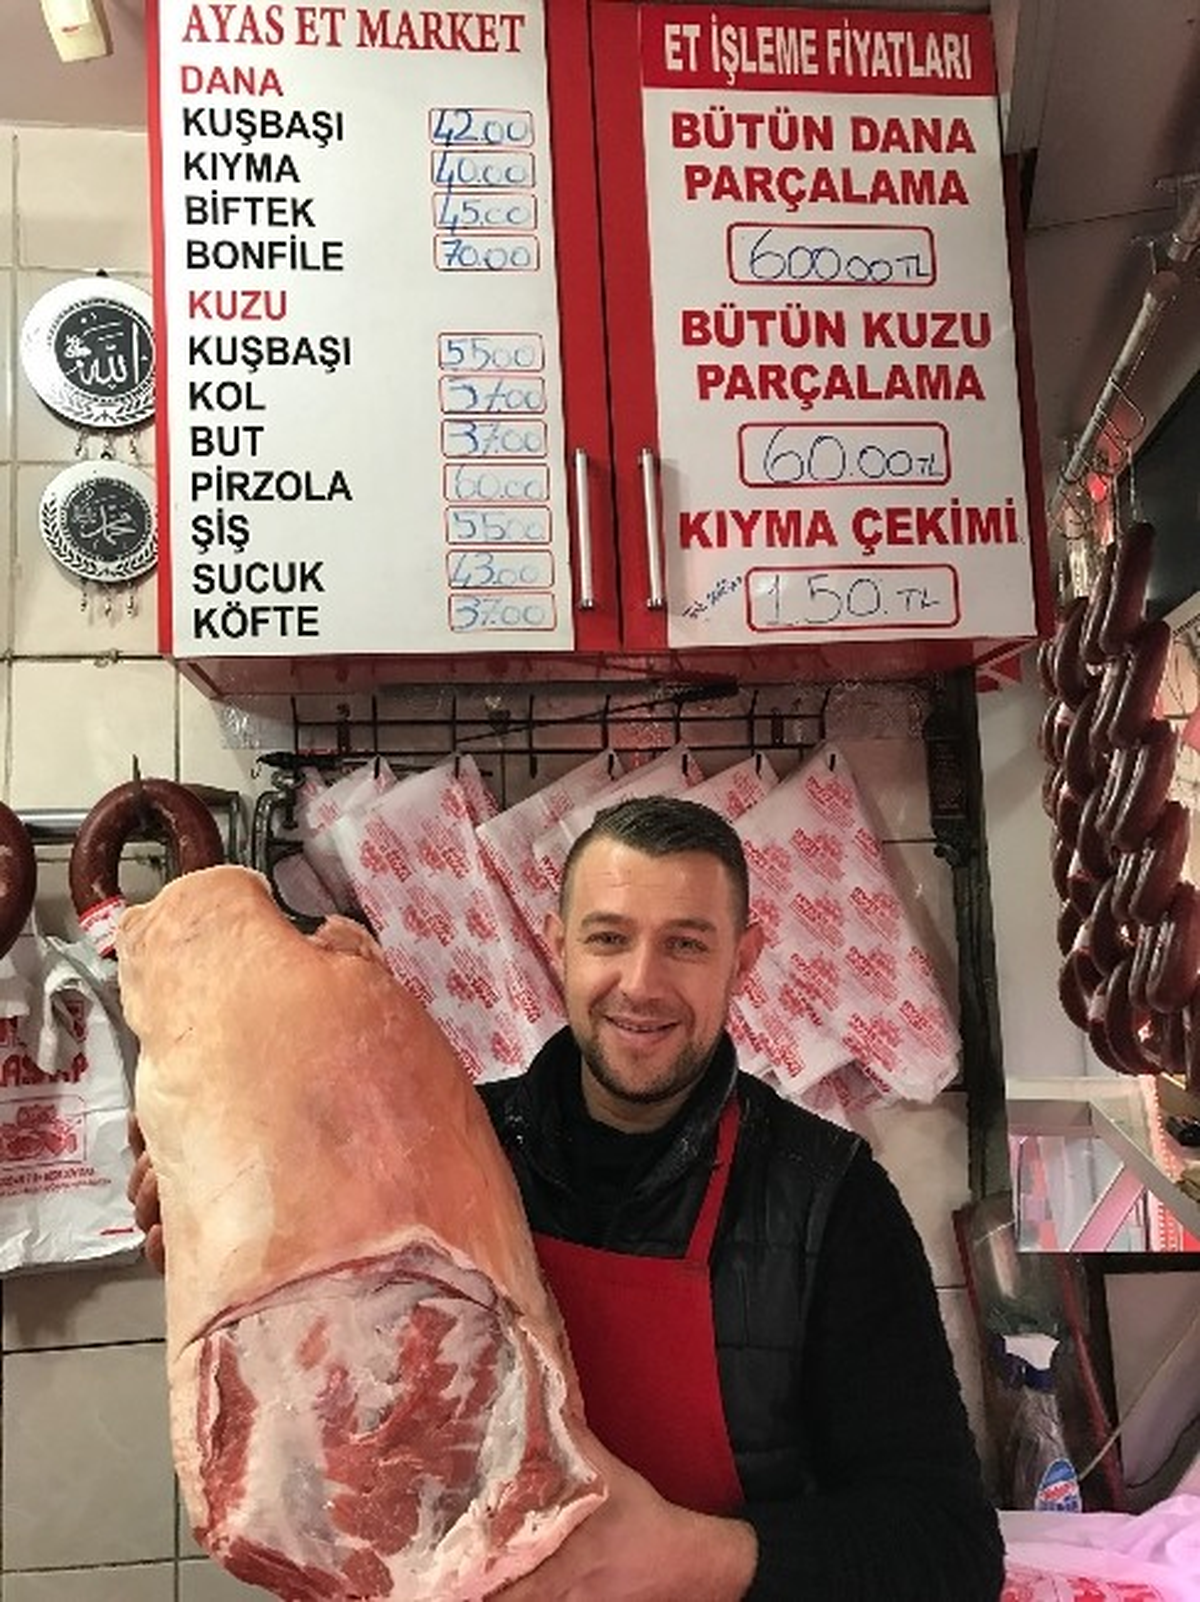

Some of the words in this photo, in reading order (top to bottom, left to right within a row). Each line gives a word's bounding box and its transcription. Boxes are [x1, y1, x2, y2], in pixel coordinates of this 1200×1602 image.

[182, 5, 284, 44] AYAS
[297, 8, 345, 46] ET
[357, 10, 526, 52] MARKET
[666, 25, 699, 70] ET
[712, 15, 818, 85] İŞLEME
[827, 19, 971, 80] FİYATLARI
[181, 66, 284, 96] DANA
[184, 108, 342, 148] KUŞBAŞI
[671, 106, 833, 152] BÜTÜN
[851, 117, 976, 154] DANA
[185, 152, 300, 182] KIYMA
[685, 165, 969, 212] PARÇALAMA
[186, 190, 315, 227] BİFTEK
[187, 235, 343, 270] BONFİLE
[190, 291, 285, 319] KUZU
[682, 303, 846, 348] BÜTÜN
[864, 314, 988, 346] KUZU
[190, 336, 350, 372] KUŞBAŞI
[190, 382, 265, 411] KOL
[698, 363, 986, 410] PARÇALAMA
[191, 426, 264, 456] BUT
[192, 466, 352, 501] PİRZOLA
[192, 508, 249, 554] ŞİŞ
[679, 508, 837, 551] KIYMA
[852, 498, 1017, 556] ÇEKİMİ
[193, 562, 325, 596] SUCUK
[195, 601, 319, 638] KÖFTE
